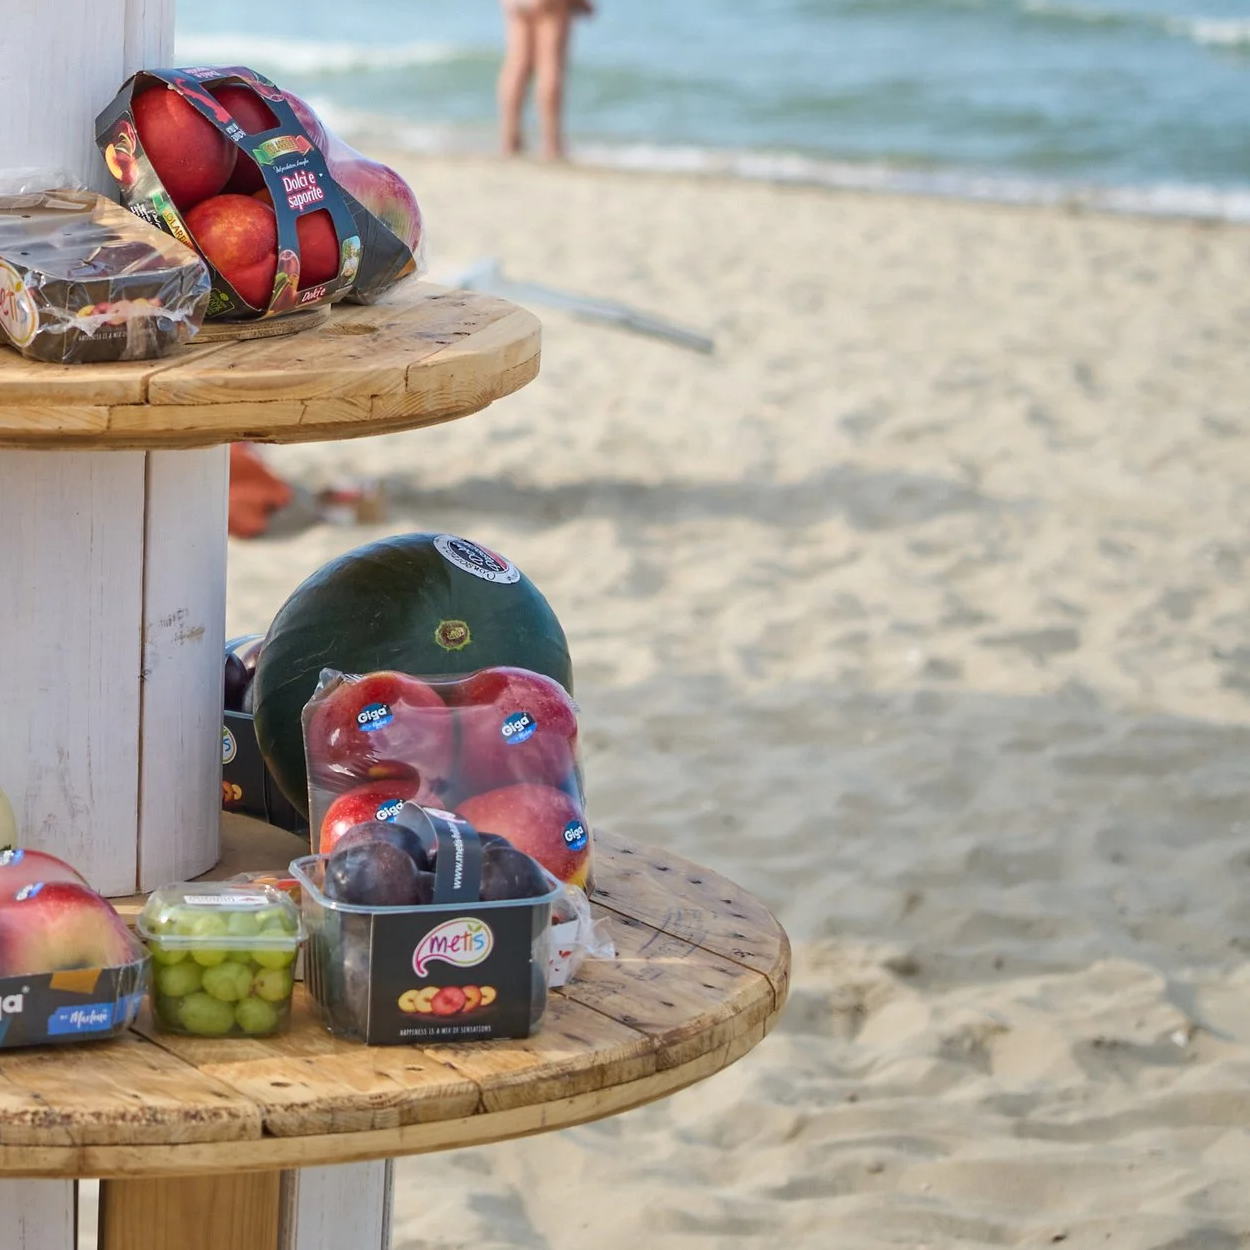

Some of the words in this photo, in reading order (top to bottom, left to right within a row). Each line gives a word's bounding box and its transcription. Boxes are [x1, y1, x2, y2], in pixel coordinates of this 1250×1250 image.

[283, 171, 307, 192] Dolci
[308, 173, 316, 184] e
[287, 186, 324, 210] saporite
[357, 705, 387, 724] Giga
[502, 715, 530, 737] Giga
[376, 802, 404, 821] Giga
[564, 825, 584, 842] Giga
[400, 1029, 427, 1037] HAPPINESS
[461, 1025, 492, 1033] SENSATIONS
